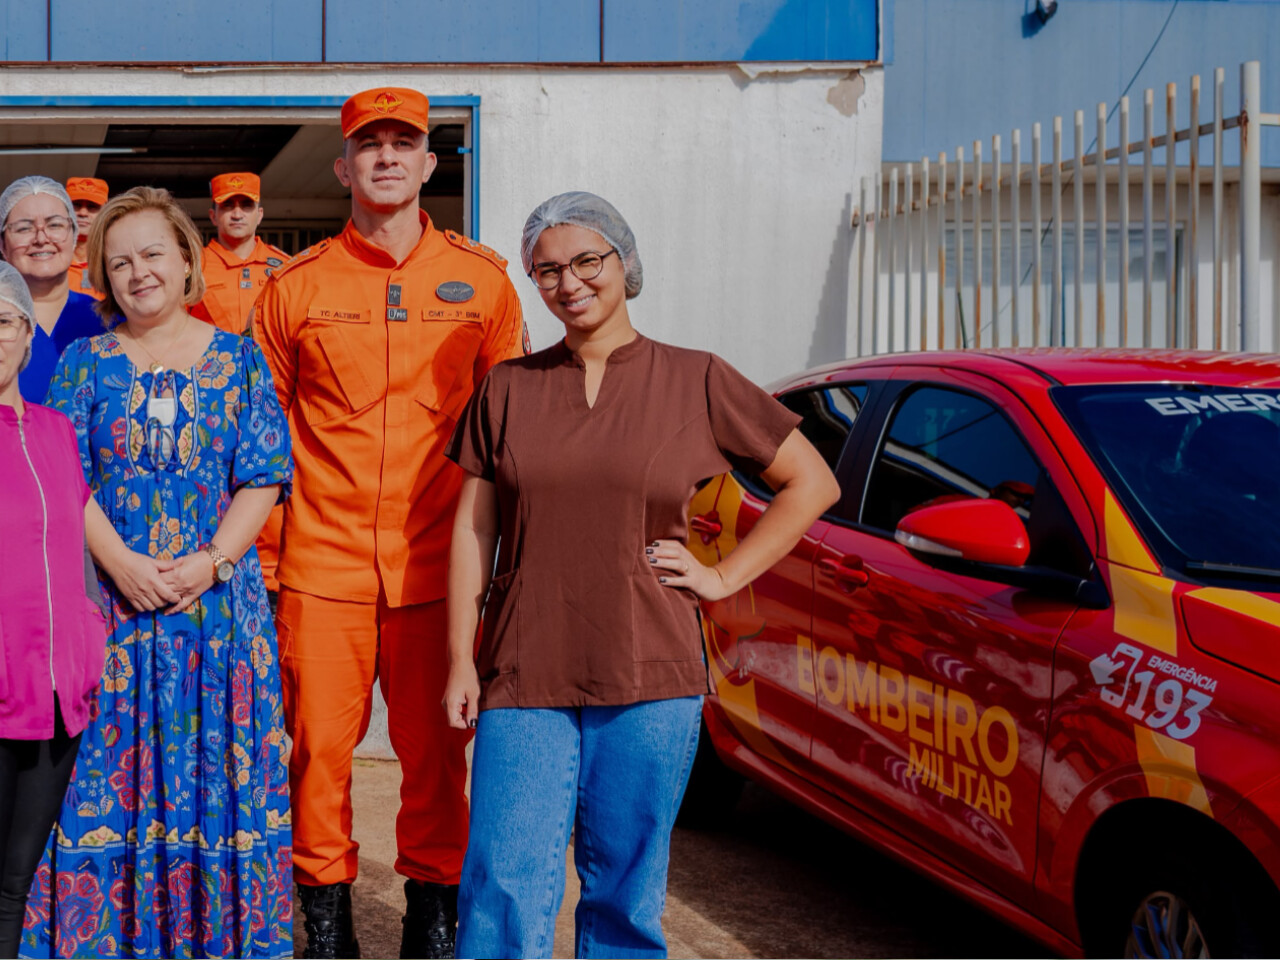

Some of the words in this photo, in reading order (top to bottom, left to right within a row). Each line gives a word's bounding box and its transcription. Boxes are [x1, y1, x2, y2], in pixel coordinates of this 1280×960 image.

[1144, 394, 1280, 415] EMER
[797, 634, 1019, 777] BOMBEIRO
[1124, 670, 1213, 739] 193
[1147, 655, 1218, 693] EMERGÊNCIA
[906, 742, 1013, 826] MILITAR
